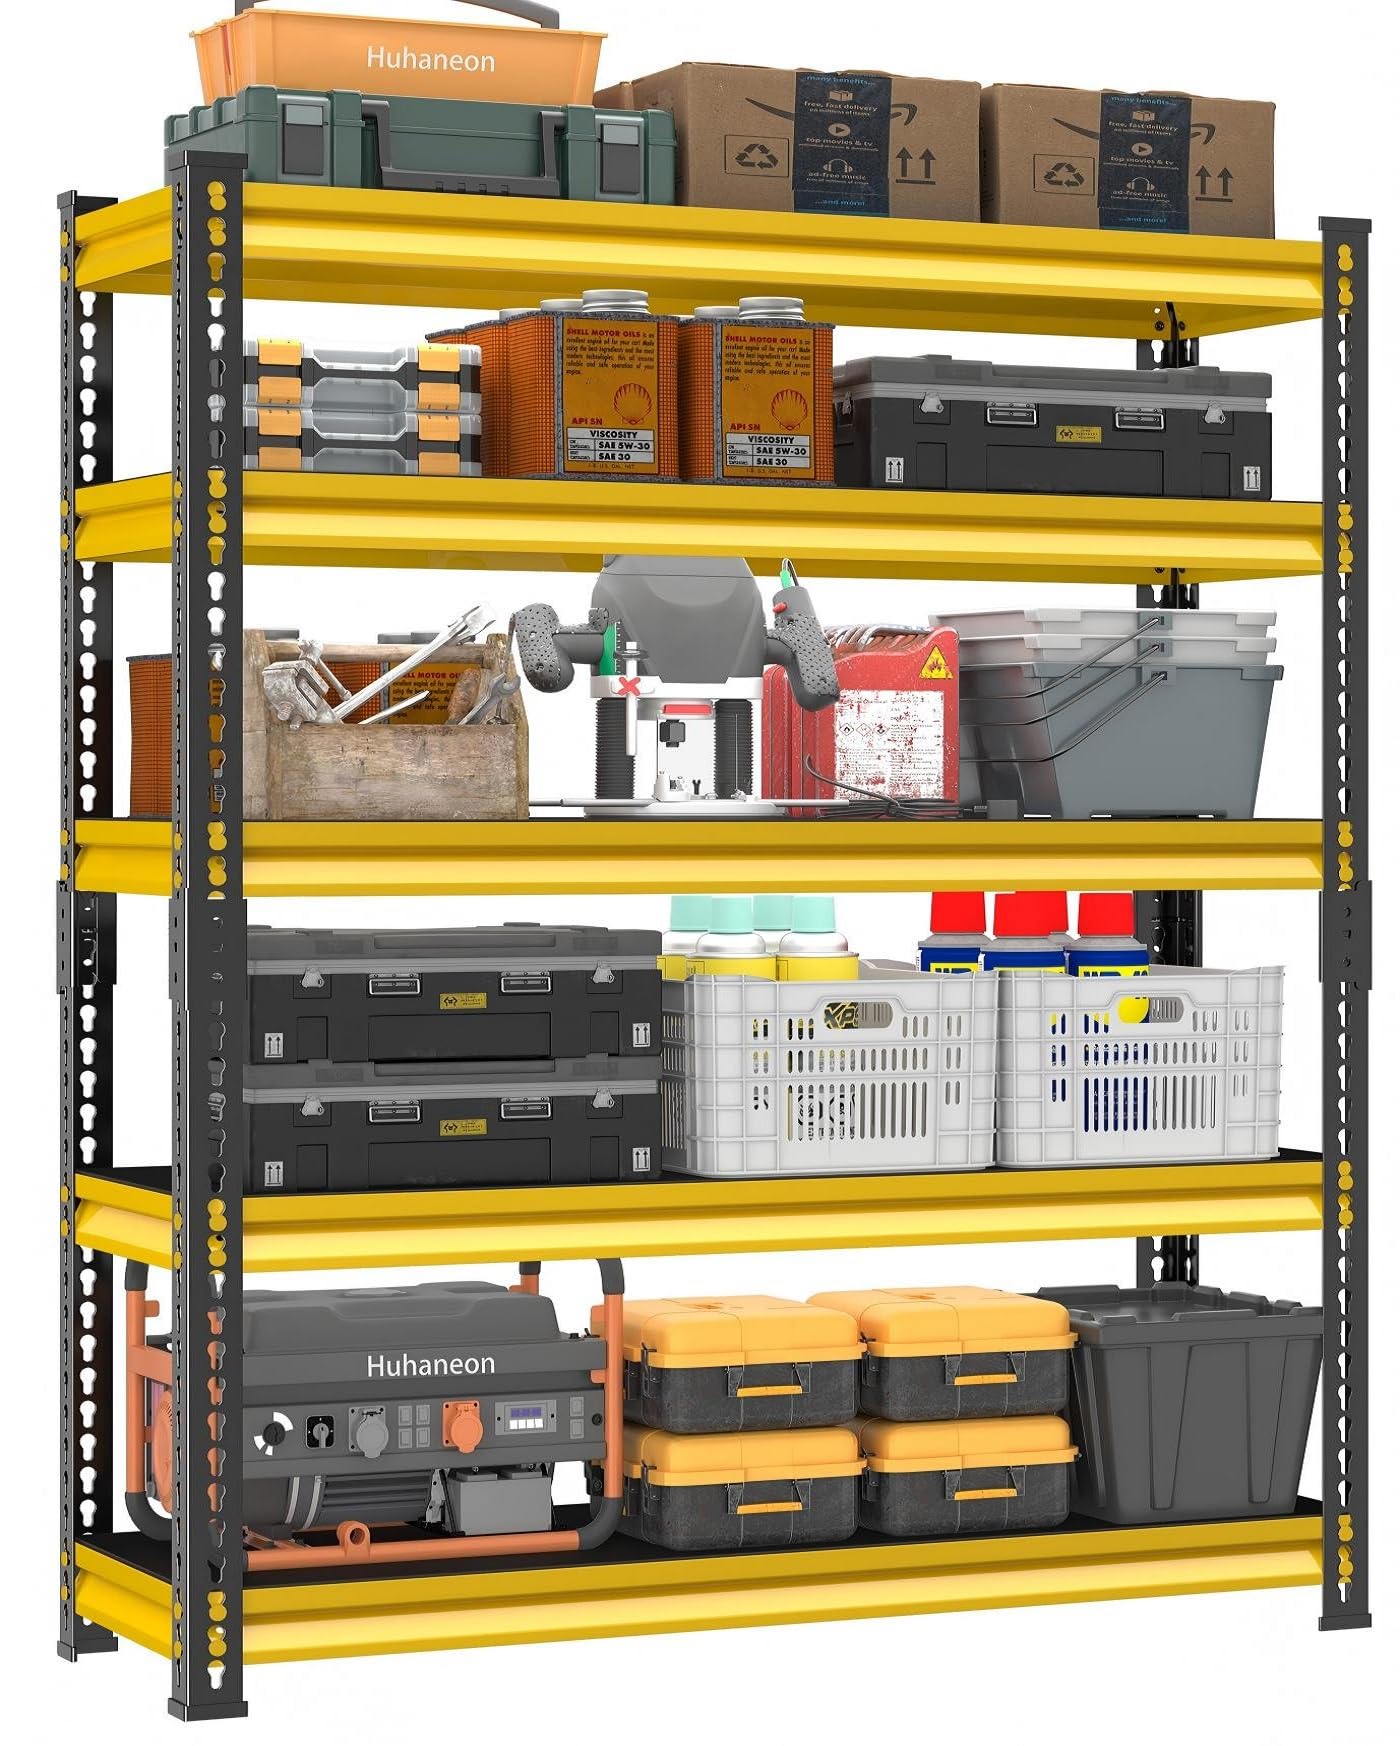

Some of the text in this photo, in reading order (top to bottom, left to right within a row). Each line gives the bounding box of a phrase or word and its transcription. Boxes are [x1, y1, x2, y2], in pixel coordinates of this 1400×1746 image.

[367, 46, 496, 72] Huhaneon
[590, 430, 638, 438] VISCOSITY
[748, 436, 795, 444] VISCOSITY
[367, 1354, 496, 1378] Huhaneon
